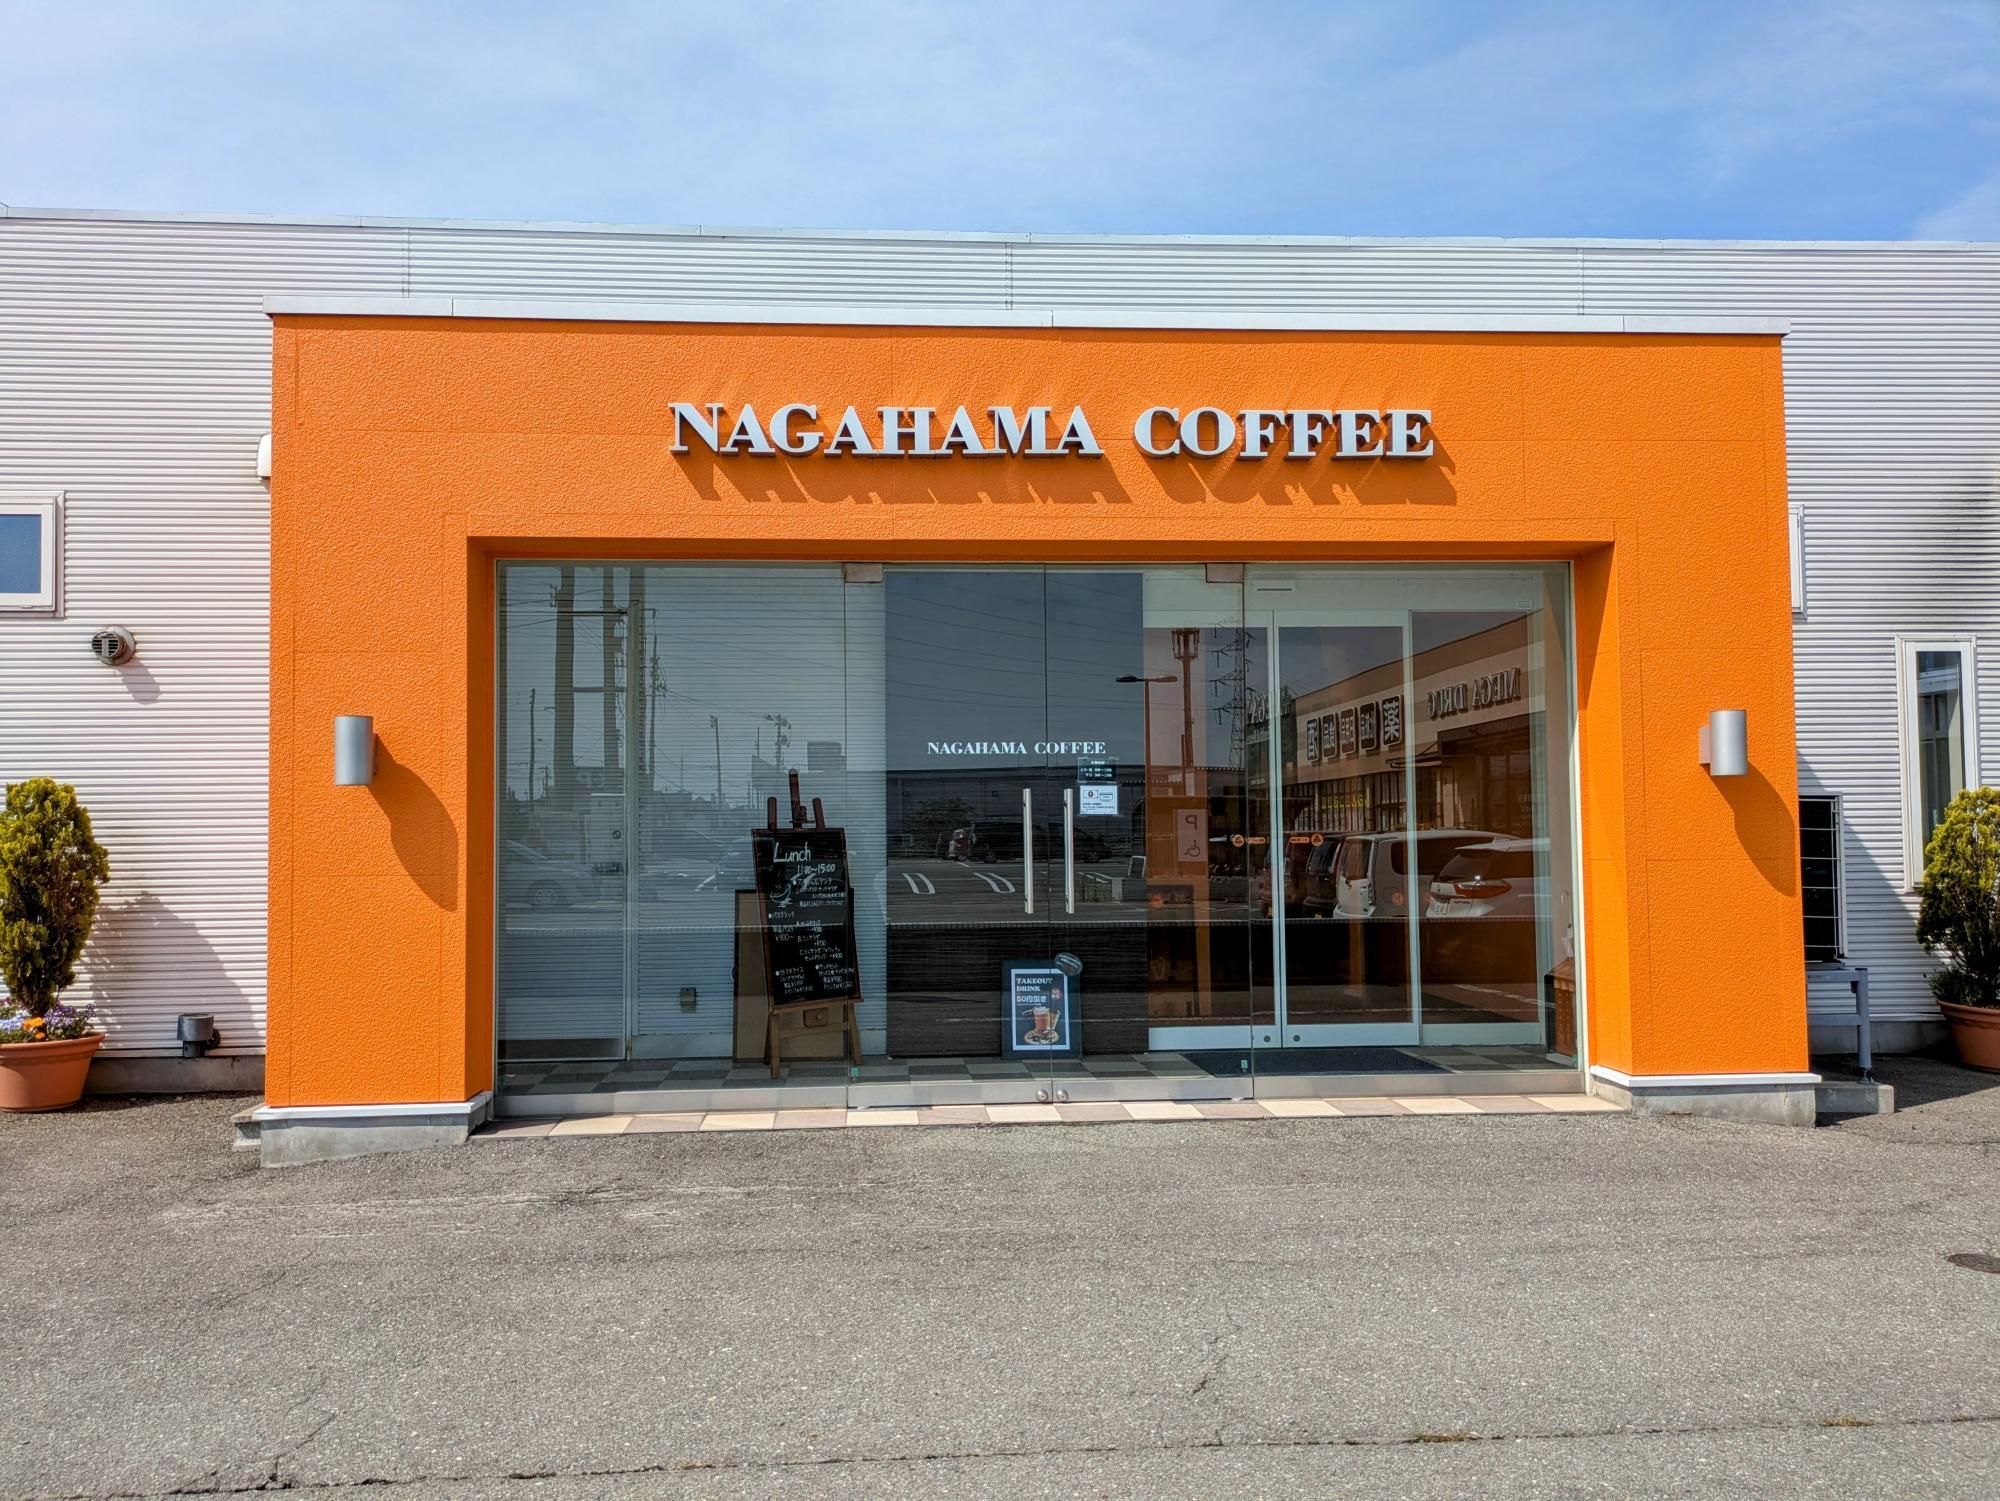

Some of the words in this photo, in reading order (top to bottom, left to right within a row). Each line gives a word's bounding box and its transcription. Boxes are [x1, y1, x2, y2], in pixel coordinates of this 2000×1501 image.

[668, 403, 1103, 459] NAGAHAMA
[1134, 407, 1436, 459] COFFEE
[927, 741, 1028, 754] NAGAHAMA
[1034, 741, 1106, 754] COFFEE
[773, 841, 812, 863] Lunch
